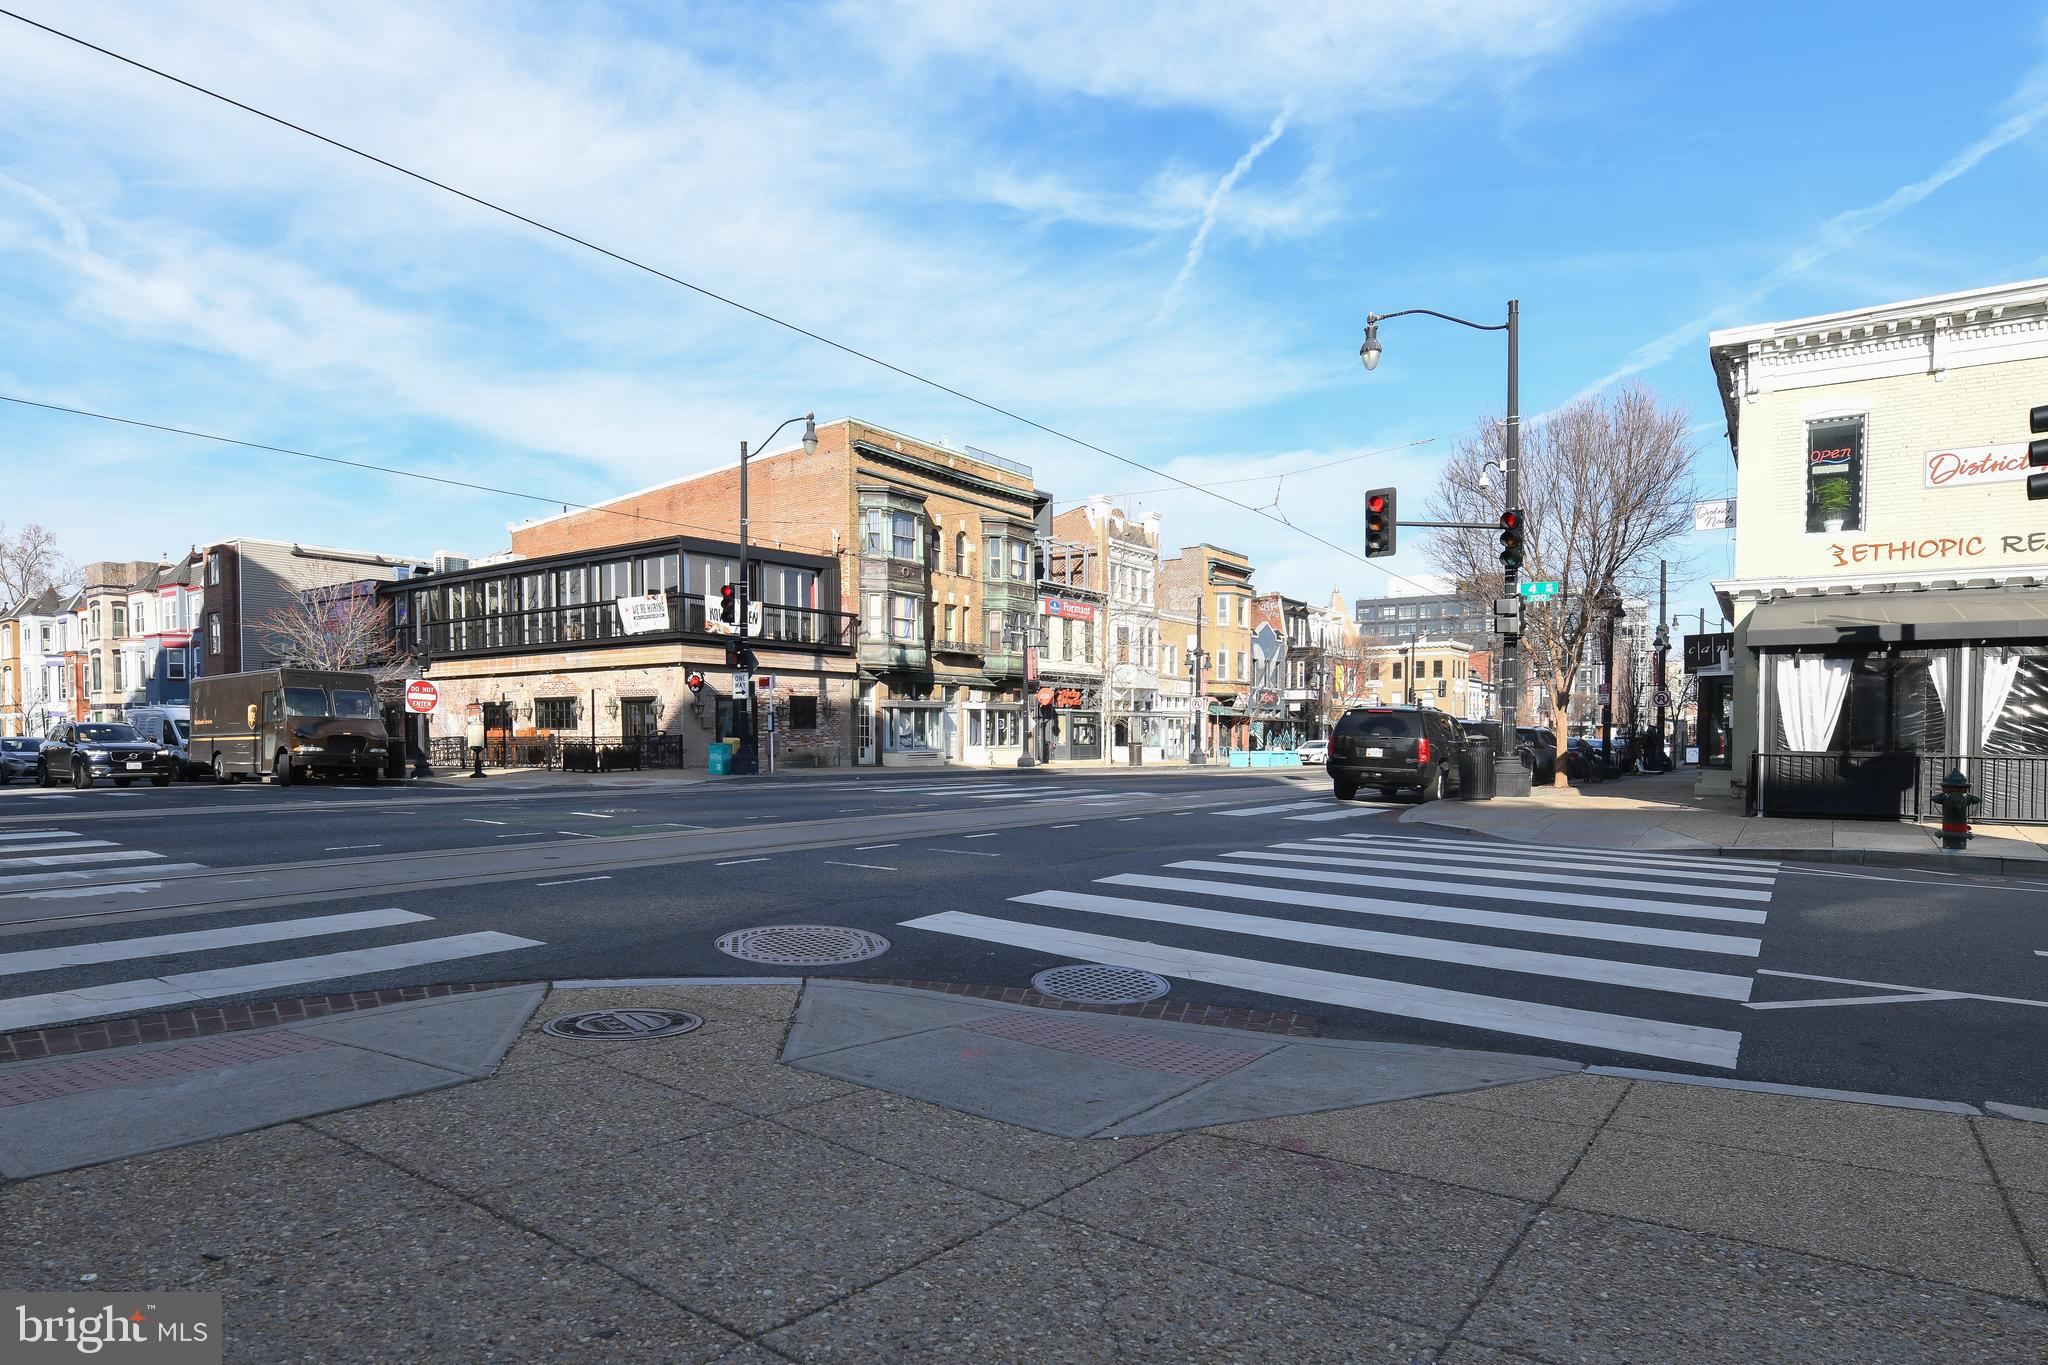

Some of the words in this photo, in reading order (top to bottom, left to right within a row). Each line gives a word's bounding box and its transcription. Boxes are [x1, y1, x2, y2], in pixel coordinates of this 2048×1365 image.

[1929, 452, 2029, 485] District
[1696, 504, 1734, 519] District
[1704, 515, 1735, 528] Nails
[1852, 536, 1986, 562] ETHIOPIC
[2001, 532, 2048, 554] RE
[1528, 584, 1537, 594] 4
[1529, 594, 1547, 602] 700
